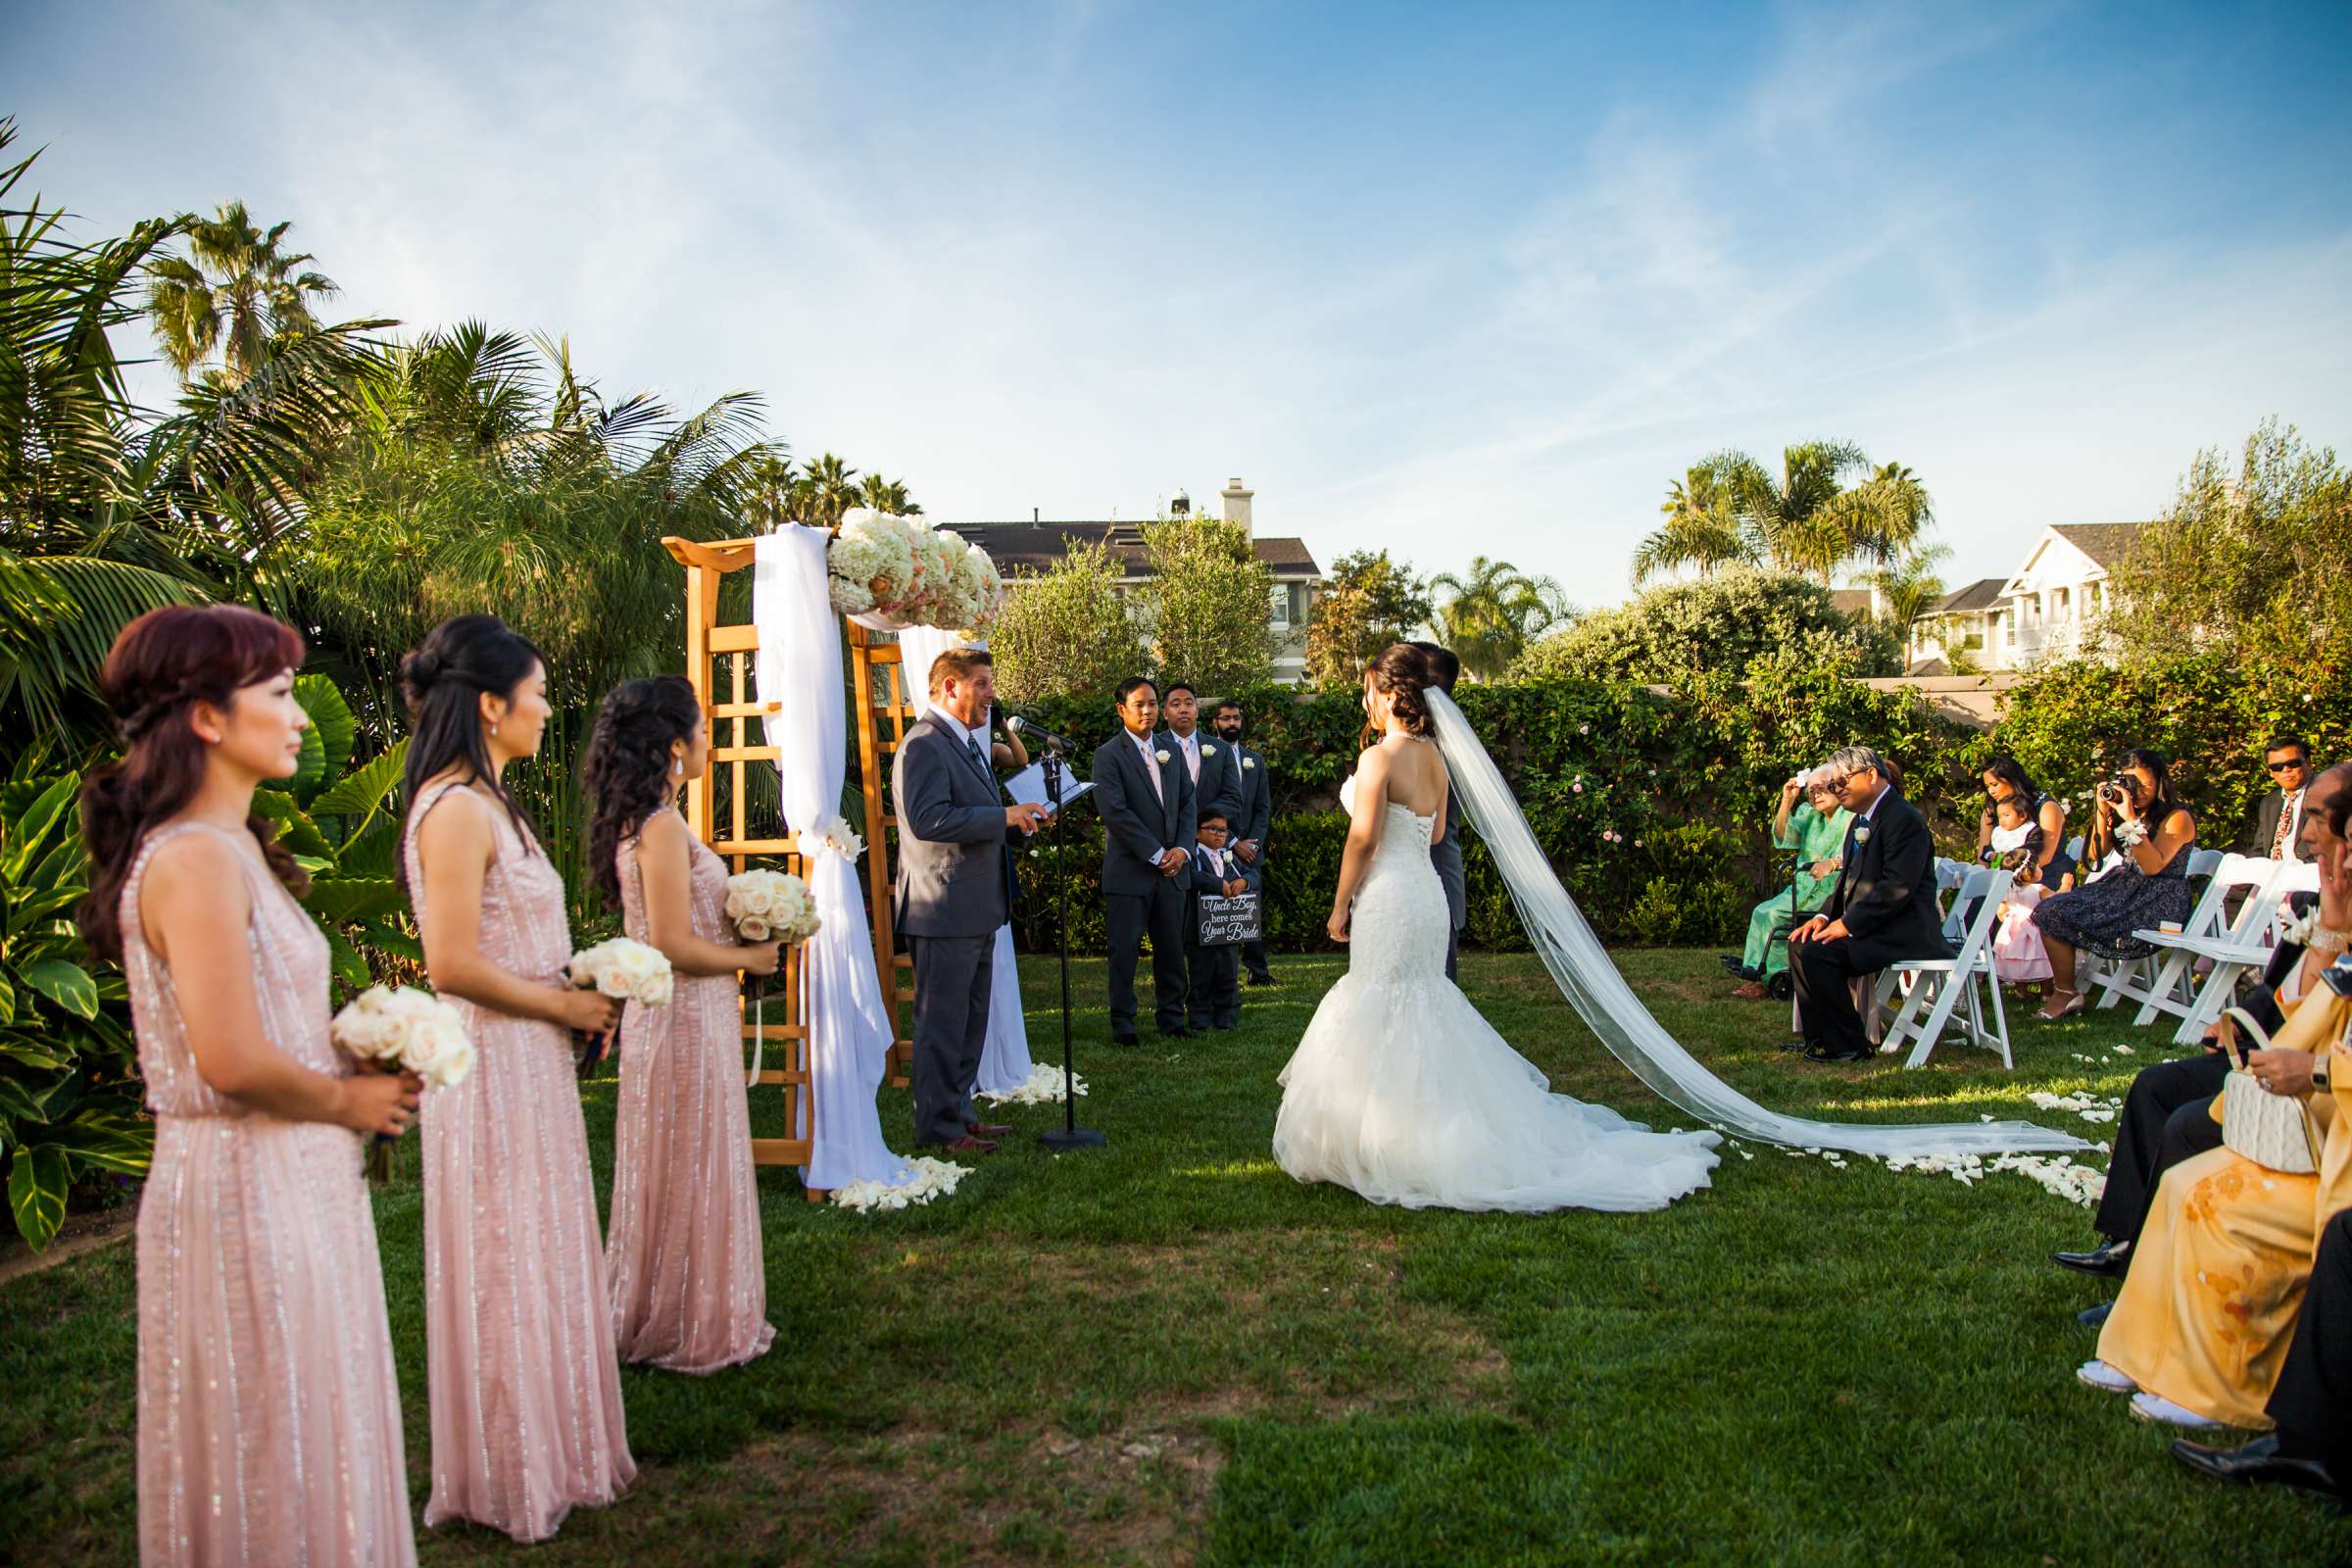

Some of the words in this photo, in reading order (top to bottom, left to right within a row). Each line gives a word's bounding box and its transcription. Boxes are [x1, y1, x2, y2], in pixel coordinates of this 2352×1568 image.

[1202, 899, 1231, 912] Uncle
[1232, 897, 1257, 913] Boy,
[1211, 913, 1229, 923] here
[1200, 920, 1225, 942] Your
[1226, 921, 1258, 941] Bride
